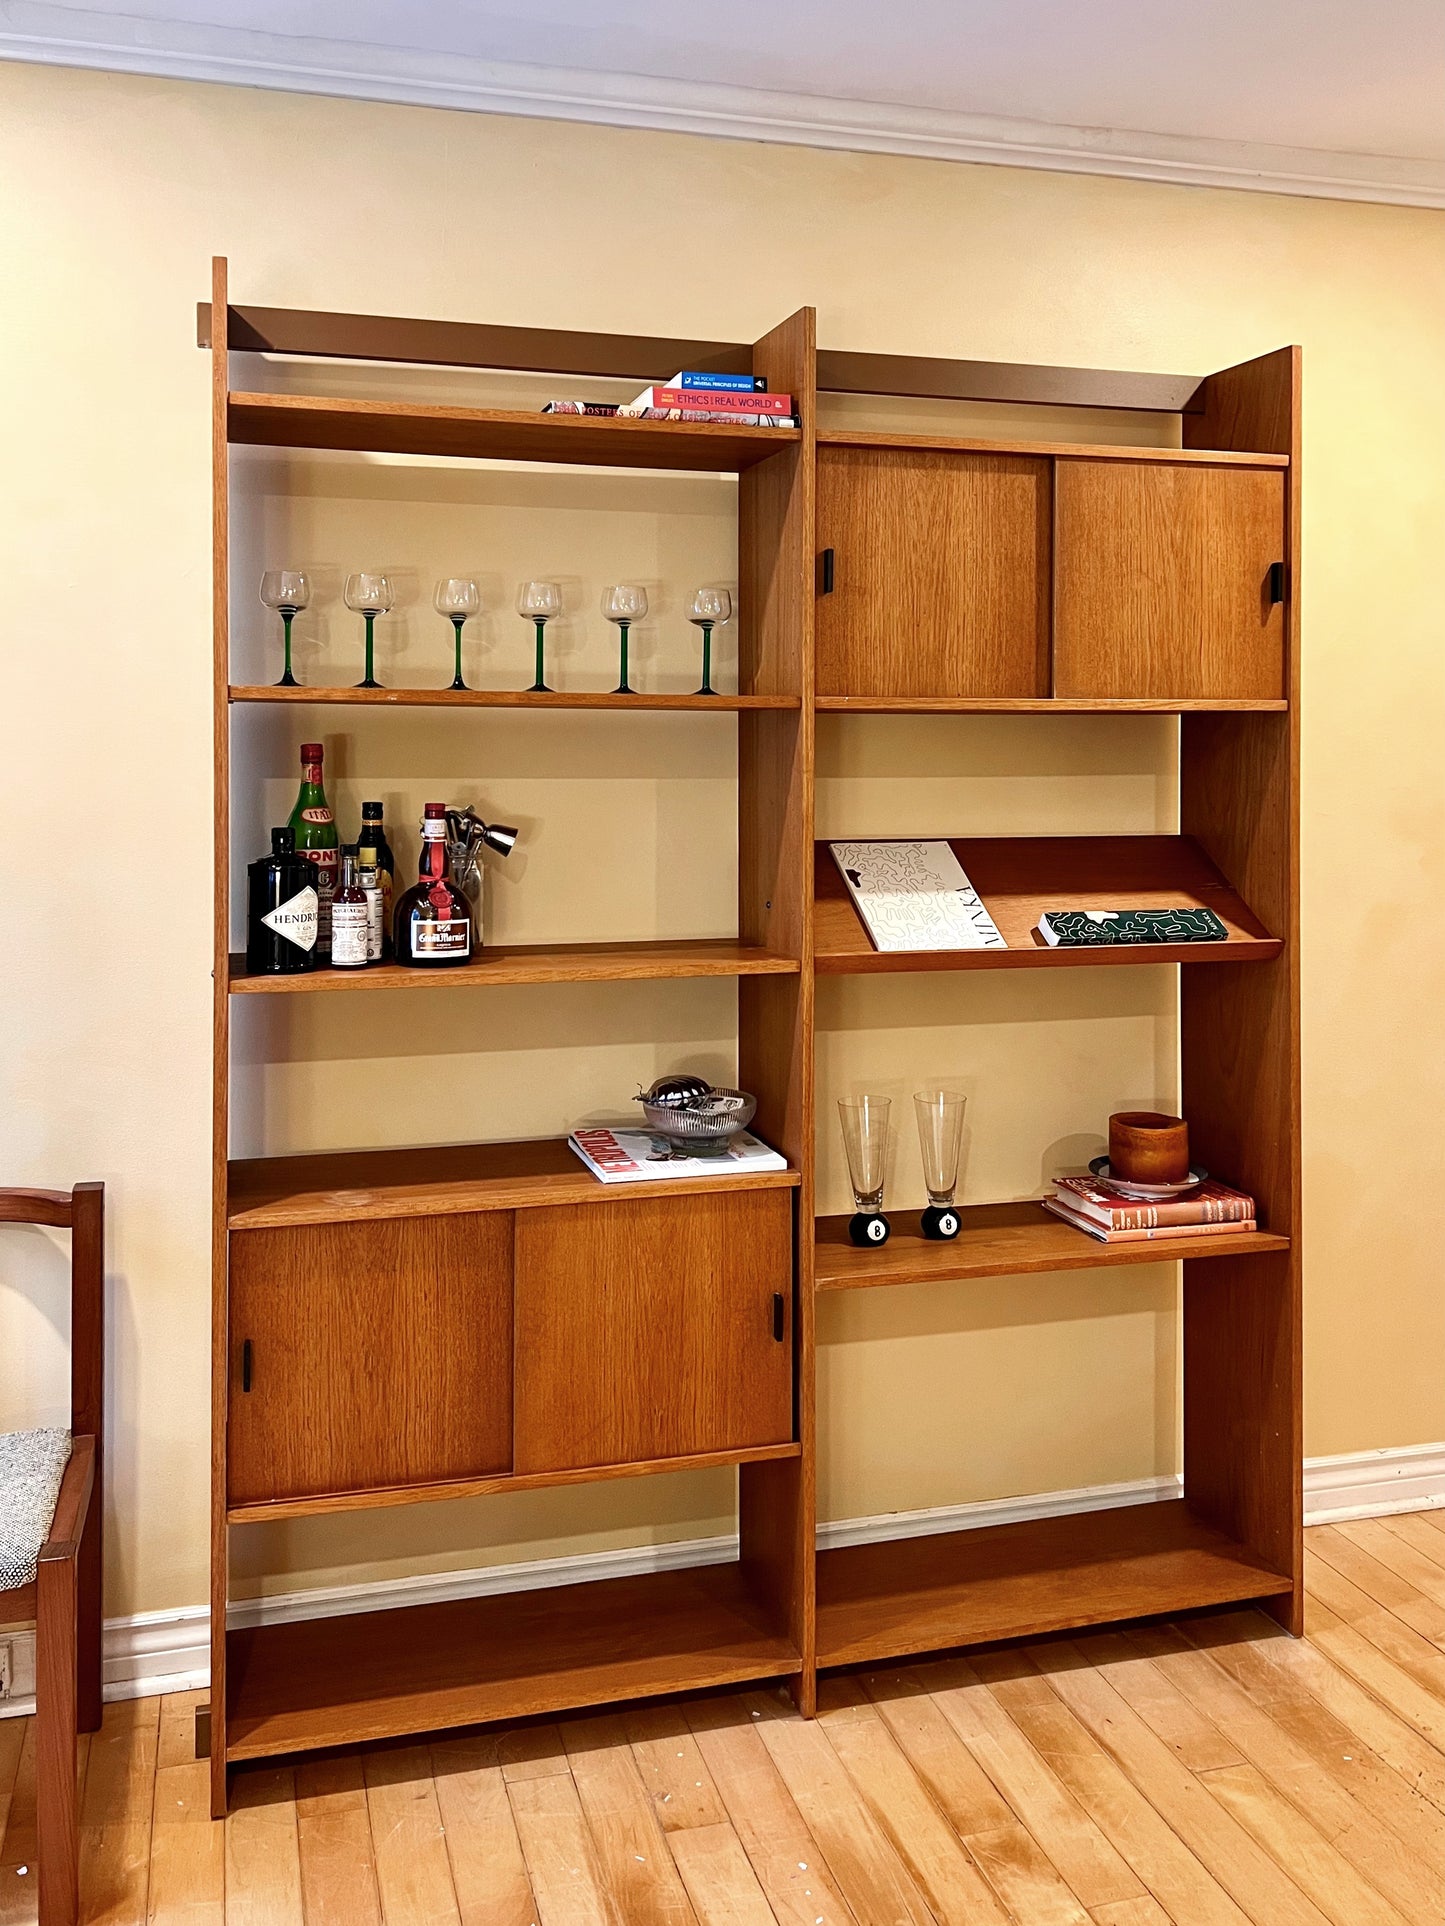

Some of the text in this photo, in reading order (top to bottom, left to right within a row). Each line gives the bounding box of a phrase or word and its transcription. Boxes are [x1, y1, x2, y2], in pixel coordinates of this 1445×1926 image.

[677, 394, 708, 405] ETHICS
[715, 397, 736, 407] REAL
[739, 398, 772, 408] WORLD
[582, 406, 624, 417] POSTERS
[574, 1129, 644, 1174] METROPOLIS
[946, 1218, 952, 1230] 8
[874, 1225, 881, 1237] 8
